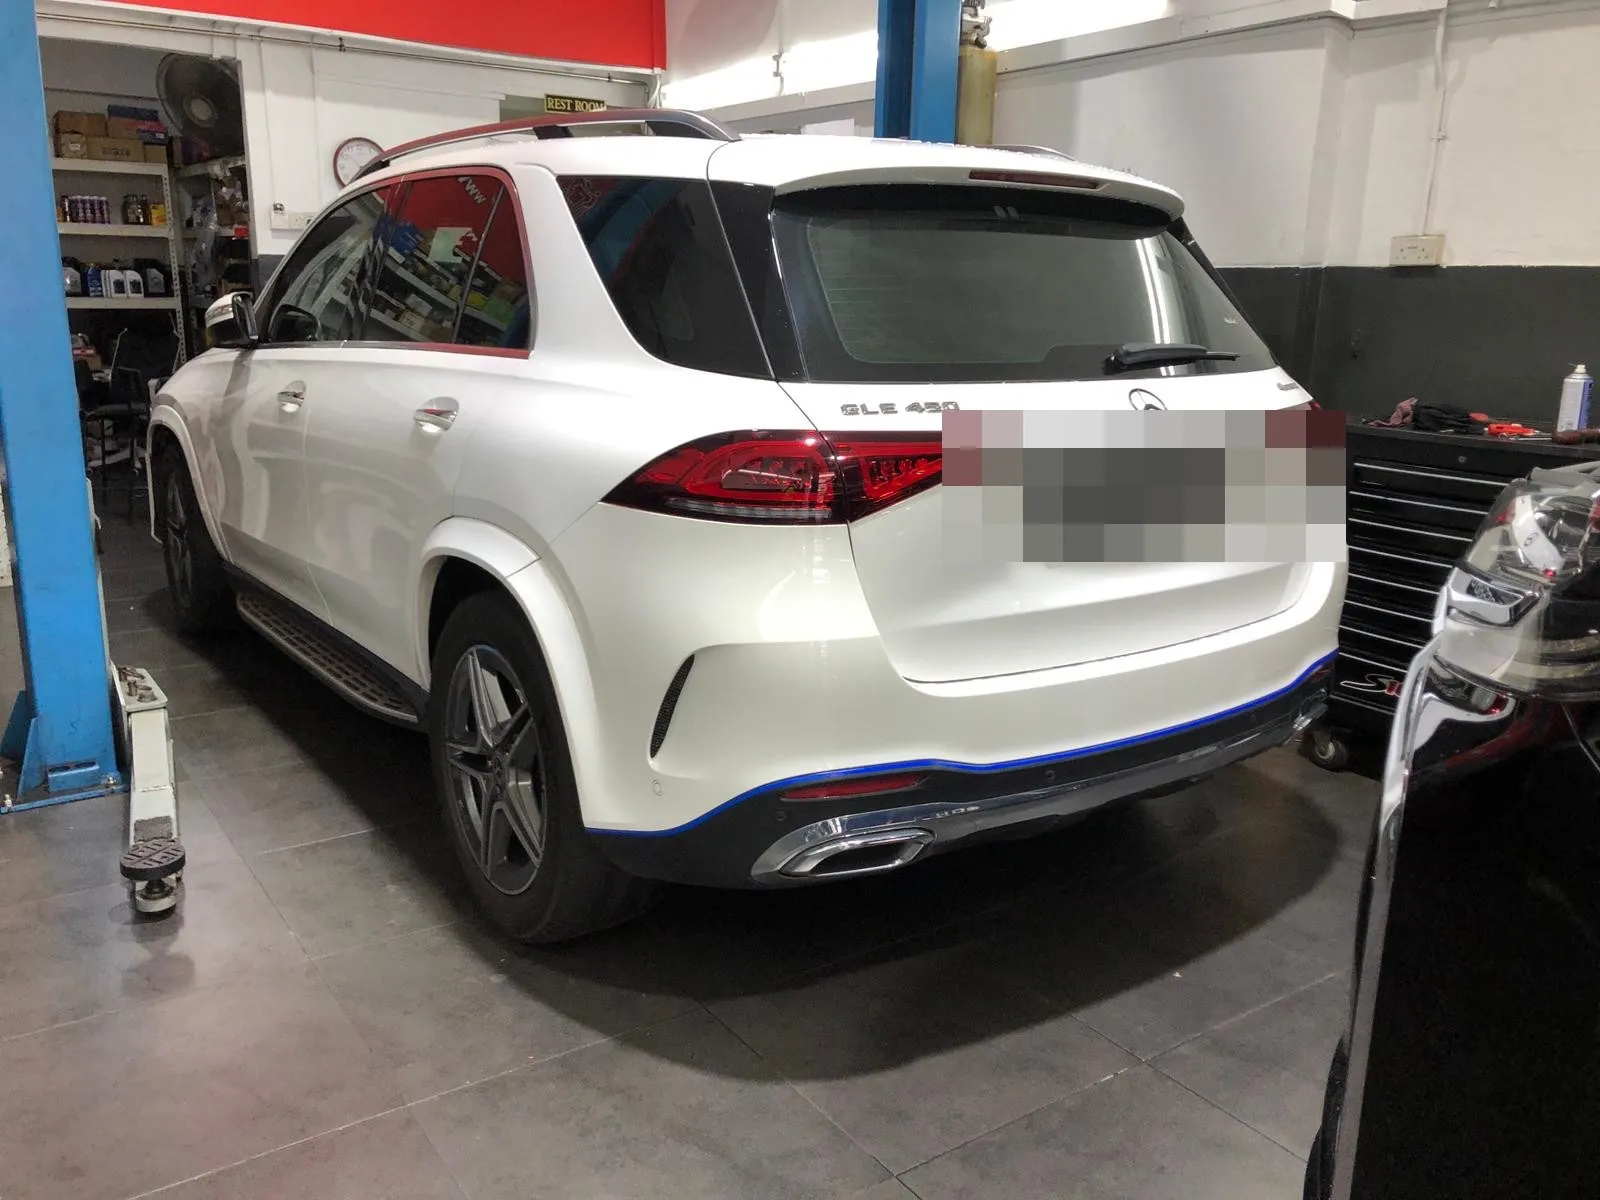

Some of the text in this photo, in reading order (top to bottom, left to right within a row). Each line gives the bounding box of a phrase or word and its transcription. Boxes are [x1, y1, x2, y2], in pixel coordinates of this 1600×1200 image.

[547, 97, 604, 112] REST ROOM
[840, 401, 960, 416] GLE 450
